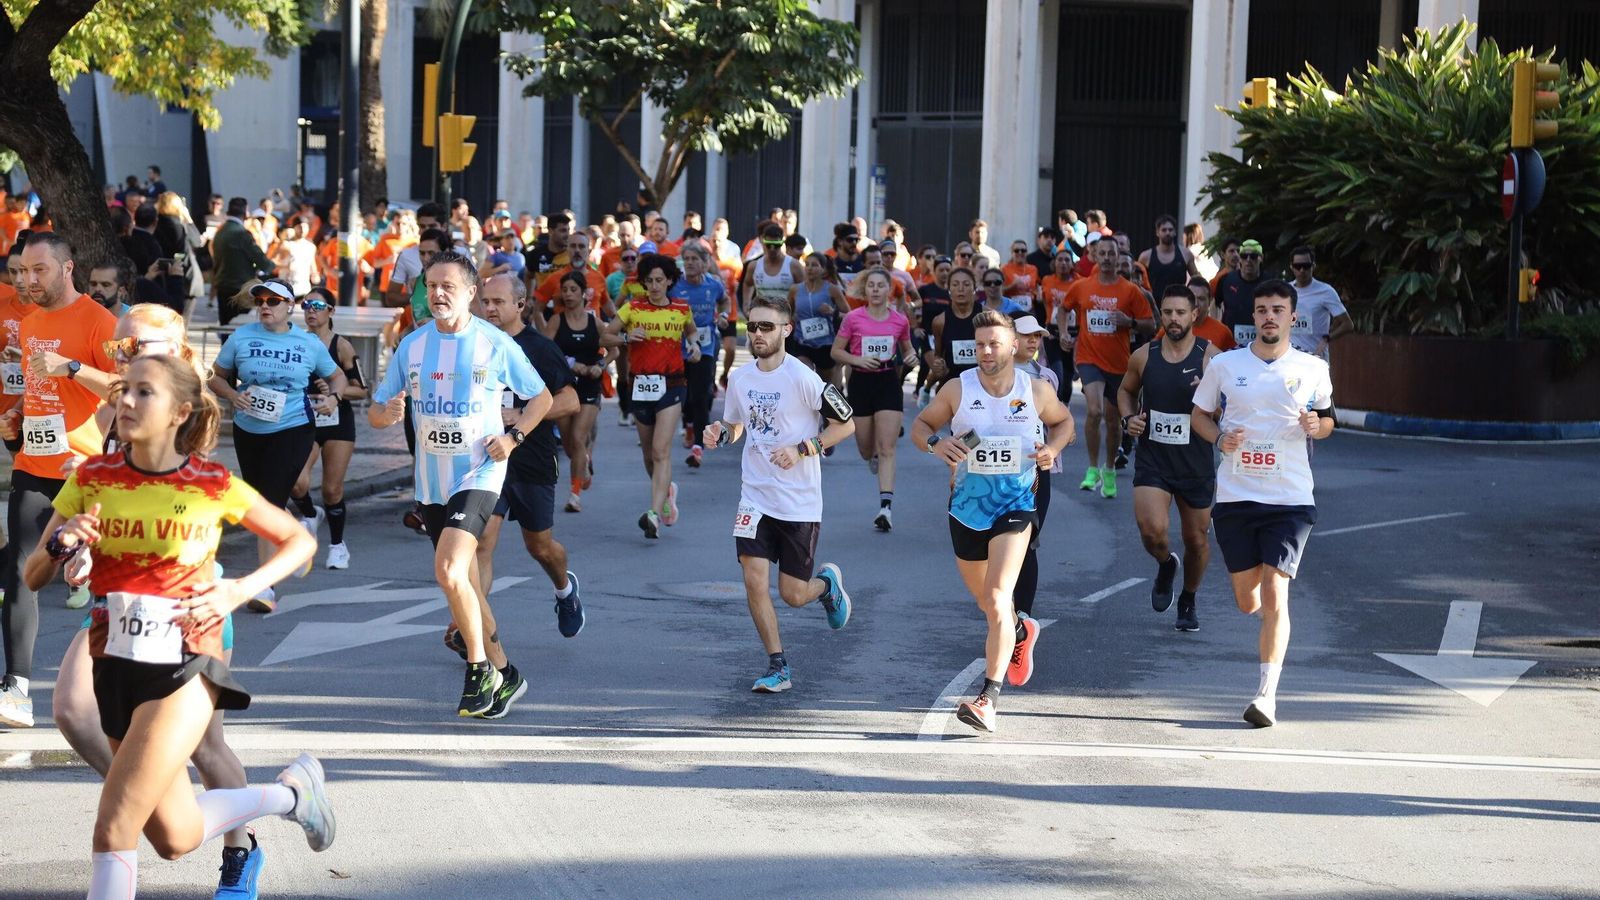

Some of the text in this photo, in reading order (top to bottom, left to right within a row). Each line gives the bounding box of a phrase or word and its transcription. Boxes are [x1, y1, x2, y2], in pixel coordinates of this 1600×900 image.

[249, 347, 302, 364] nerja
[256, 361, 295, 371] ATLETISMO
[638, 384, 659, 392] 942
[1155, 422, 1182, 434] 614
[27, 430, 57, 444] 455
[428, 430, 463, 444] 498
[975, 449, 1011, 463] 615
[1241, 452, 1275, 465] 586
[118, 616, 172, 638] 1027
